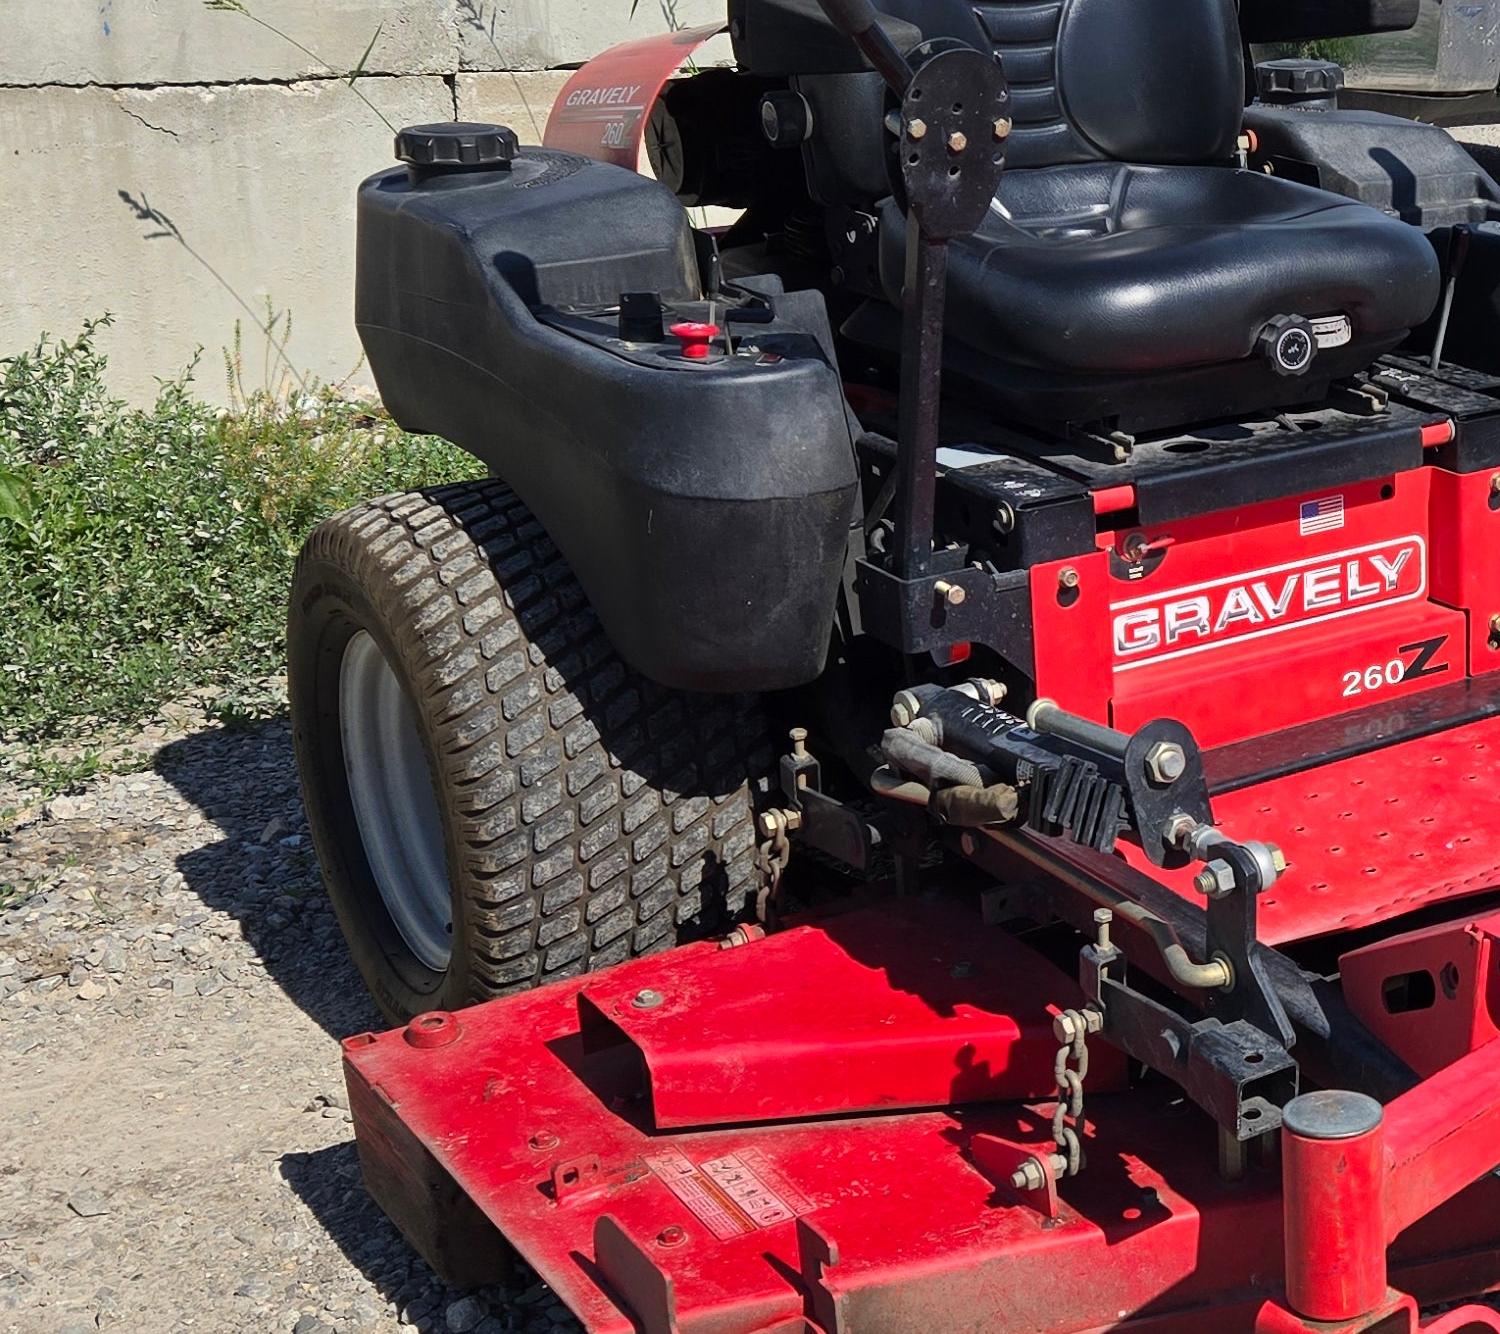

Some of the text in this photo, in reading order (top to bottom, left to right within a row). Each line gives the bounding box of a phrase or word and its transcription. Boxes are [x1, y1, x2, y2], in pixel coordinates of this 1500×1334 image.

[566, 85, 641, 106] GRAVELY
[1113, 547, 1415, 656] GRAVELY
[1342, 635, 1449, 698] 260Z
